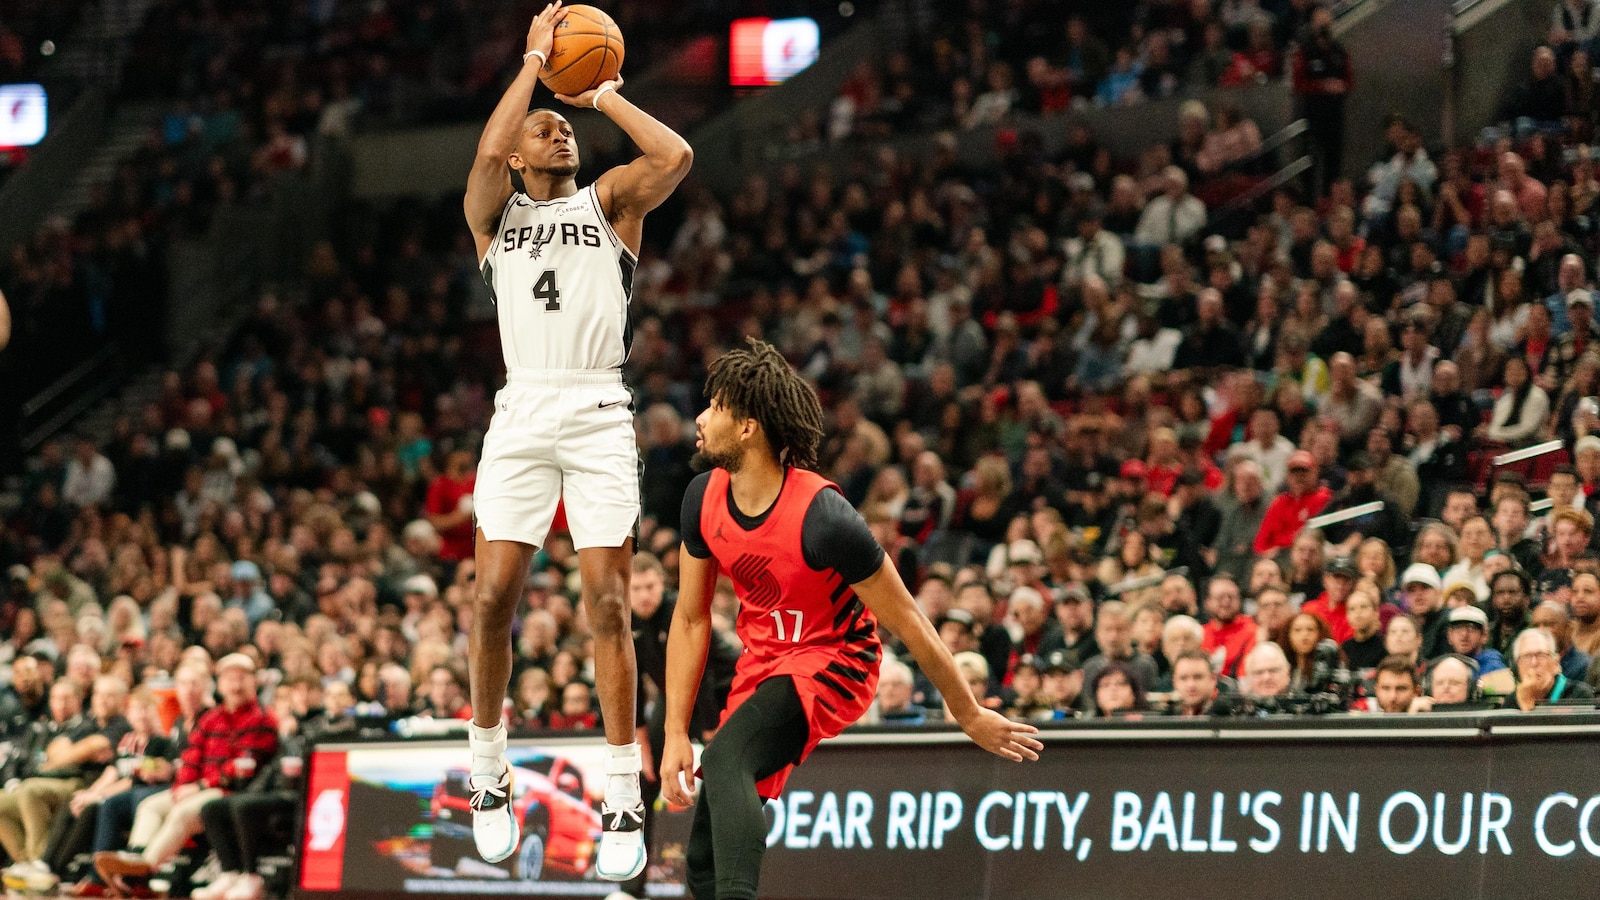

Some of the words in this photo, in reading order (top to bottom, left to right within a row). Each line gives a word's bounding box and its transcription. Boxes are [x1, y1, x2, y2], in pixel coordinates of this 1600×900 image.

[504, 223, 601, 260] SPURS
[532, 269, 562, 312] 4
[769, 609, 804, 643] 17
[886, 791, 963, 849] RIP
[975, 791, 1092, 861] CITY,
[1111, 791, 1282, 852] BALL'S
[1300, 791, 1360, 852] IN
[1379, 791, 1513, 855] OUR
